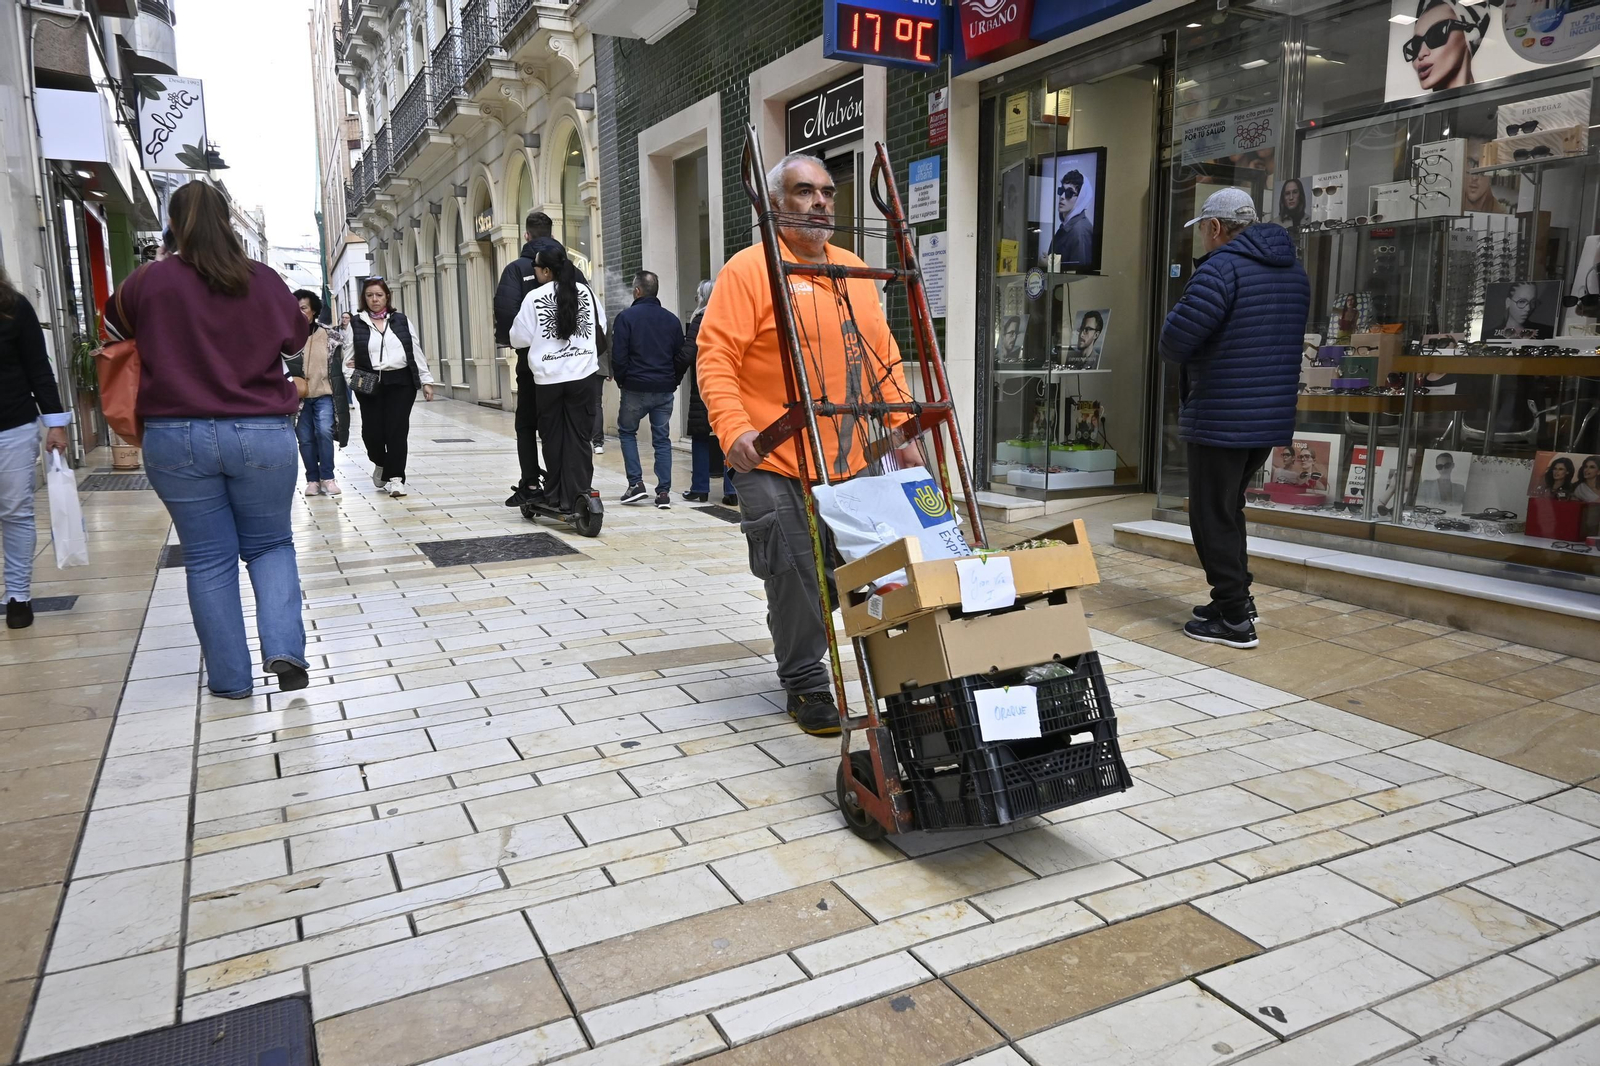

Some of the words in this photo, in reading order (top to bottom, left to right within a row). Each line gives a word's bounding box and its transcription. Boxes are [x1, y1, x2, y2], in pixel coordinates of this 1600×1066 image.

[852, 12, 881, 52] 17
[969, 4, 1017, 38] URBANO
[804, 93, 863, 138] Malvón
[1522, 102, 1562, 116] PERTEGAZ
[1184, 133, 1197, 142] POR
[1206, 126, 1226, 136] SALUD
[1194, 120, 1226, 132] PREOCUPAMOS
[939, 530, 962, 556] Expr
